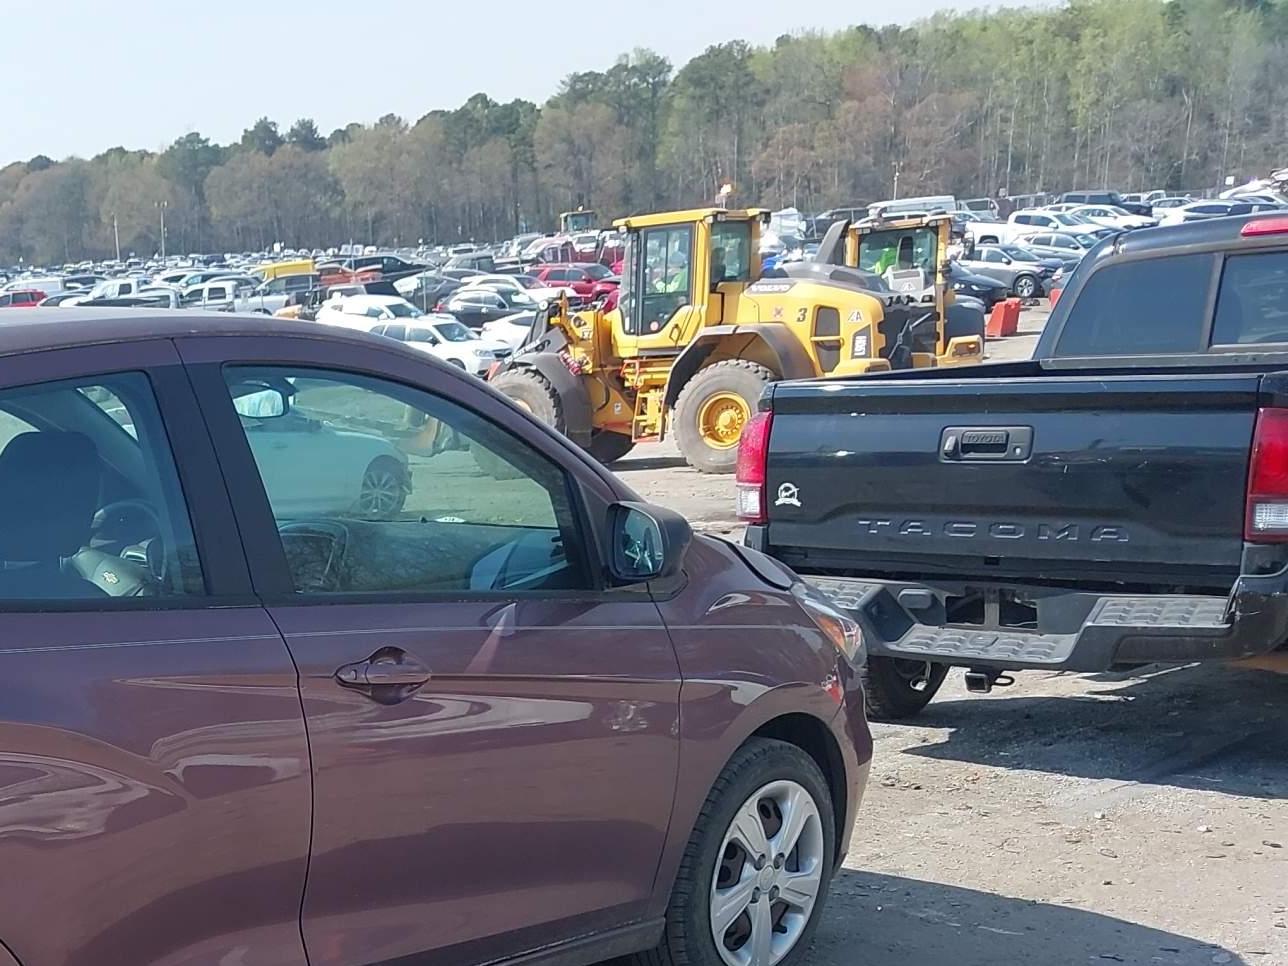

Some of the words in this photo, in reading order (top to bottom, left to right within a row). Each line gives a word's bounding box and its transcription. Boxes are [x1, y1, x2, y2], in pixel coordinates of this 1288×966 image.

[751, 284, 791, 292] VOLVO
[797, 307, 808, 322] 3
[858, 520, 1129, 542] TACOMA
